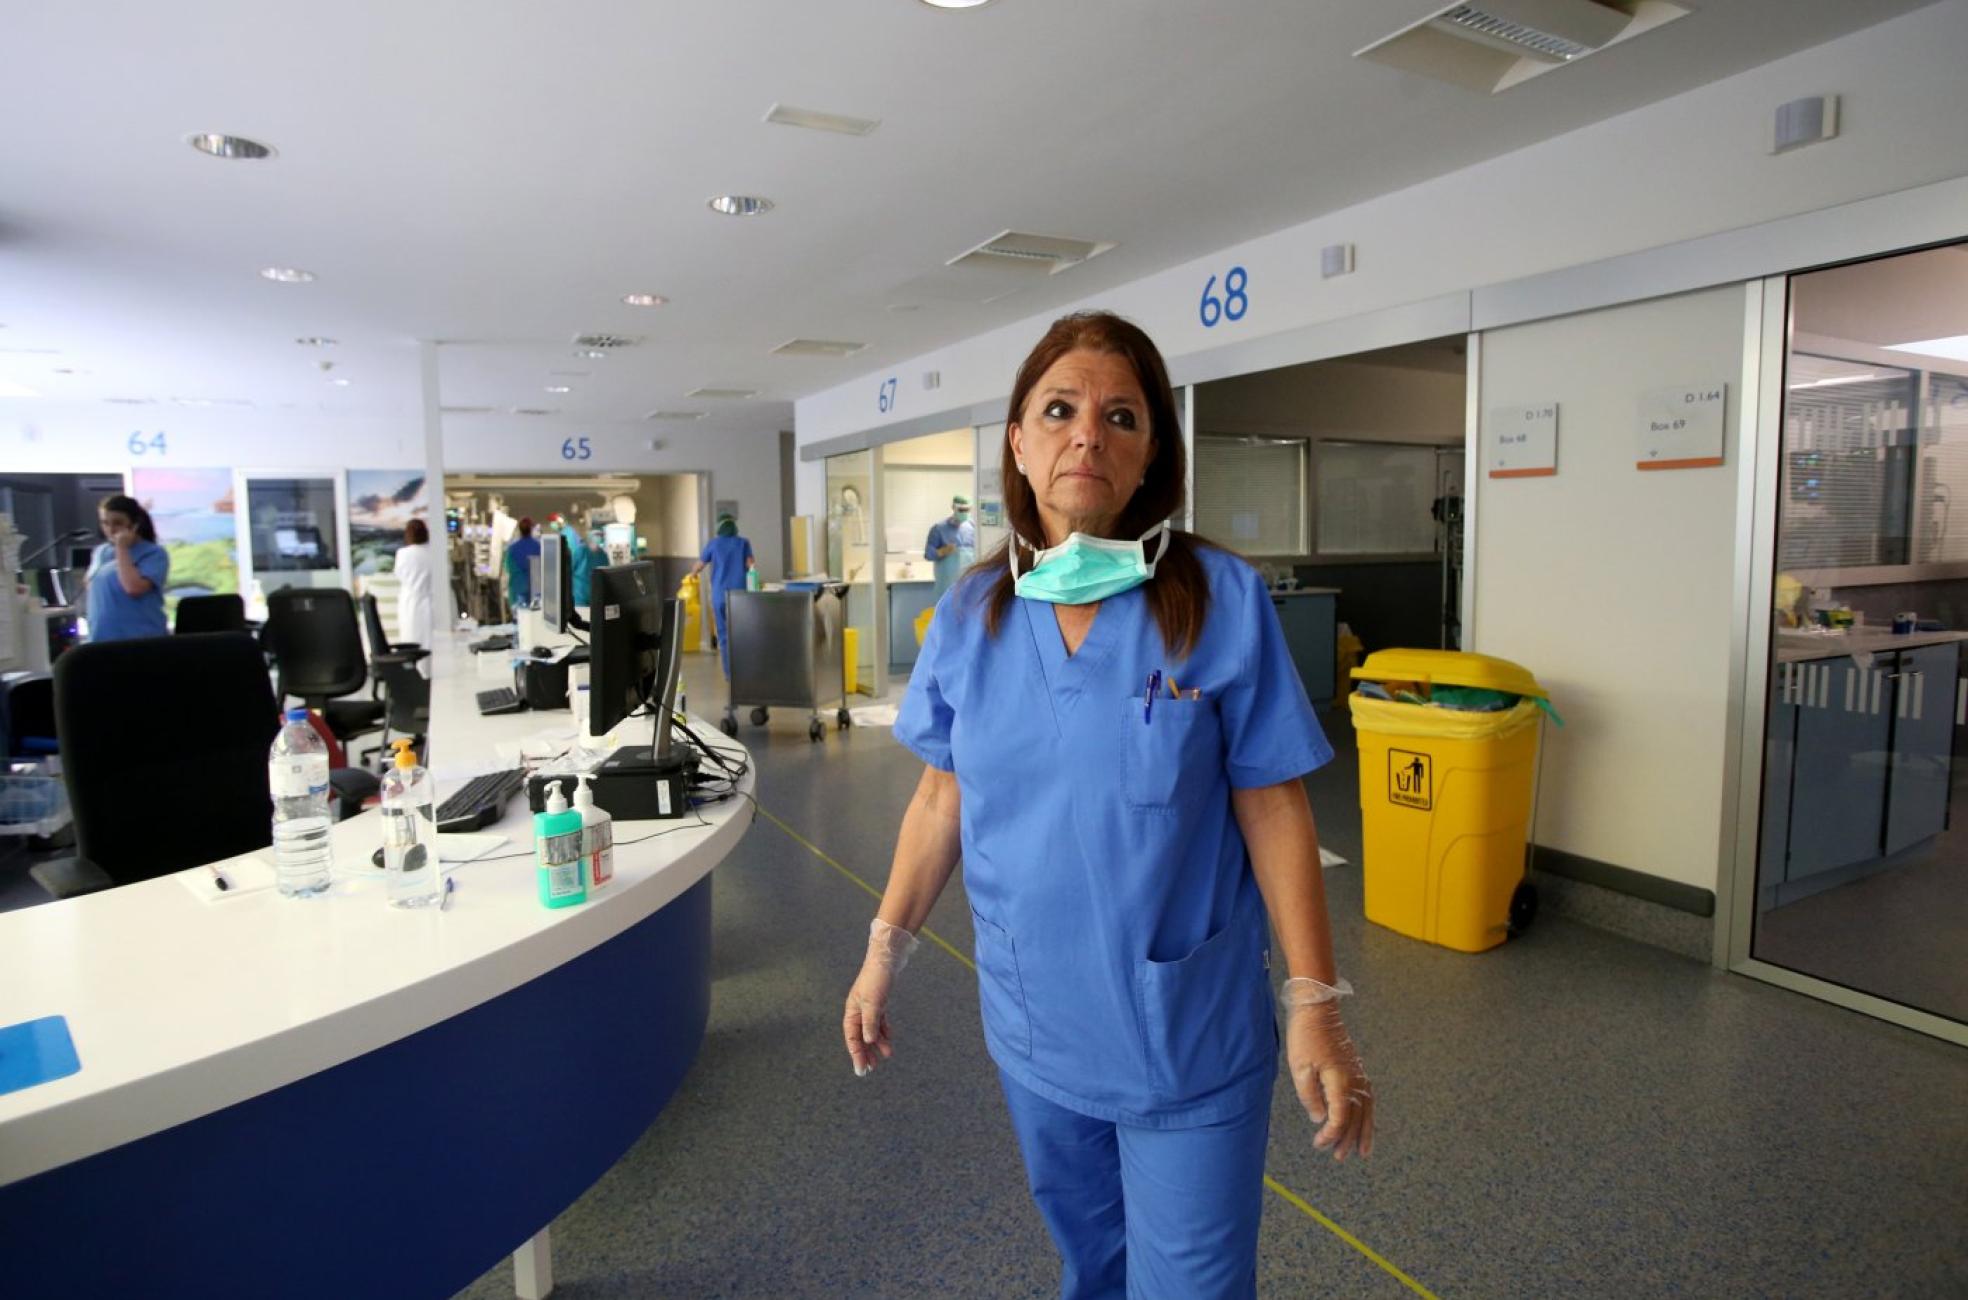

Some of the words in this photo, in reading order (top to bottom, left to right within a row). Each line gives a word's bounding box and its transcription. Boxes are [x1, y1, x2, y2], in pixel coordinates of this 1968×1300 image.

[1200, 266, 1249, 328] 68
[879, 377, 897, 413] 67
[1685, 393, 1695, 403] D
[1651, 422, 1669, 431] Box
[1673, 419, 1685, 430] 69
[128, 430, 168, 456] 64
[561, 437, 592, 460] 65
